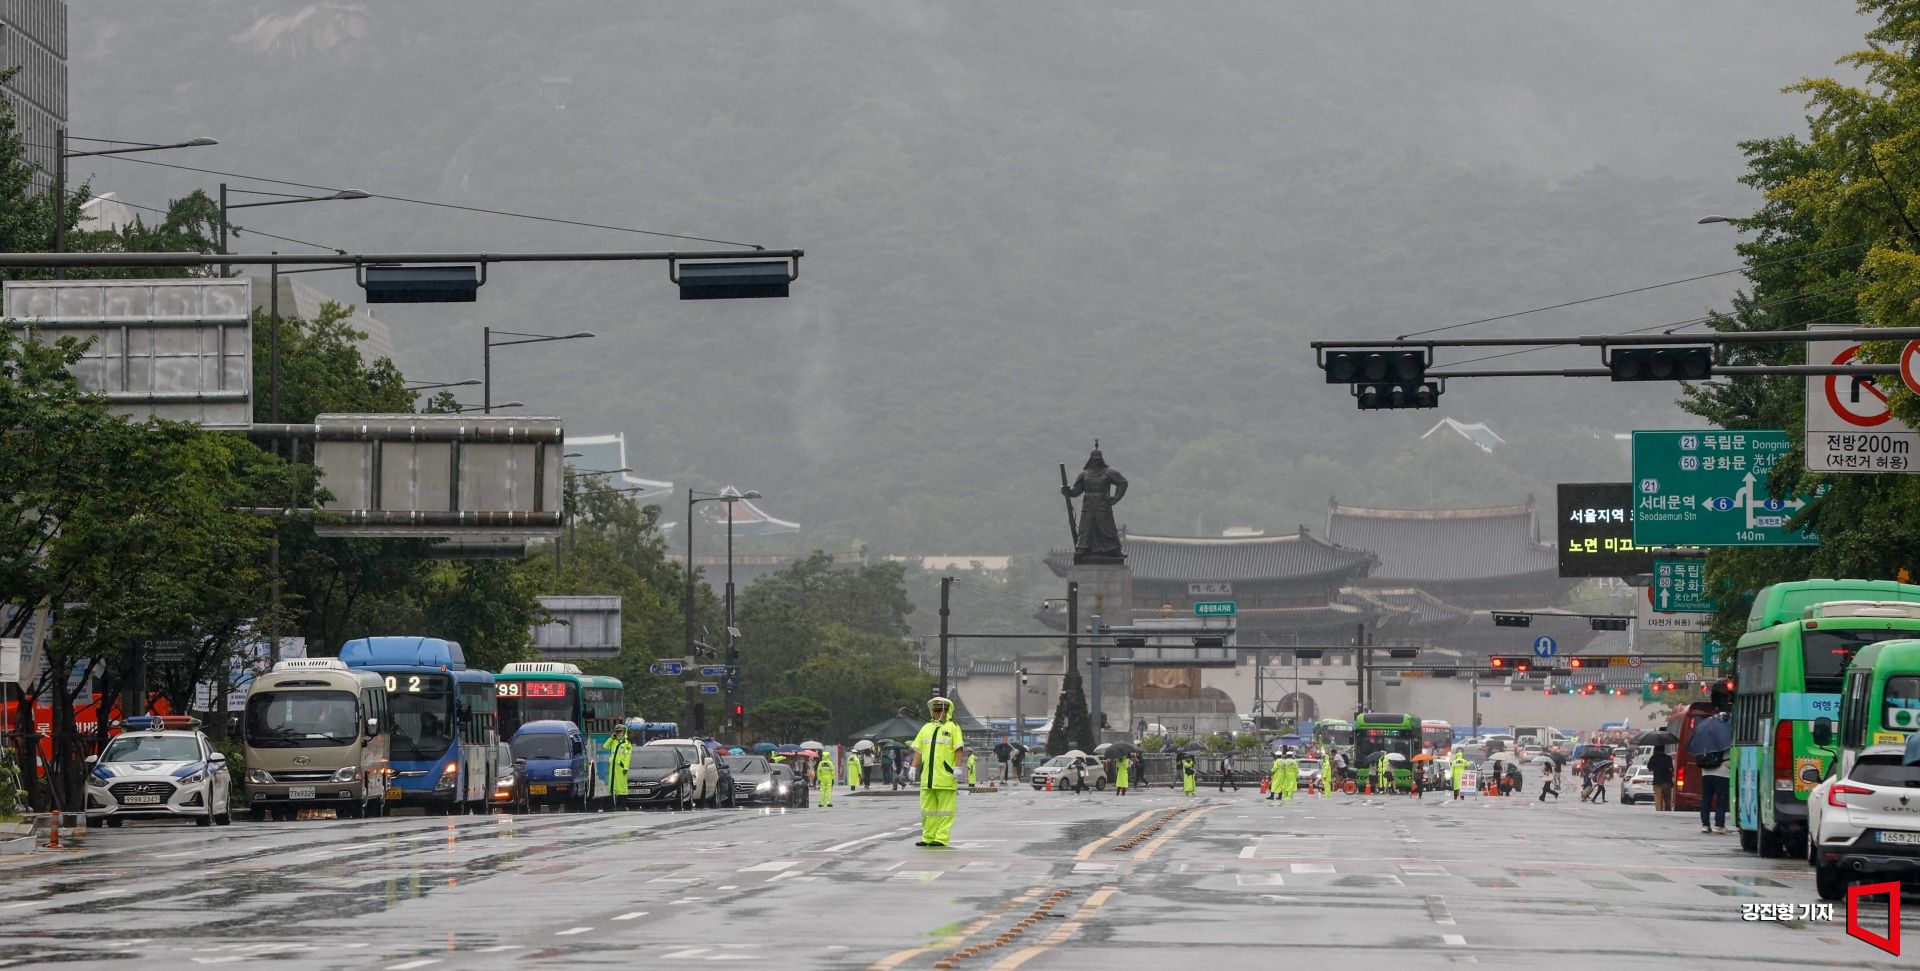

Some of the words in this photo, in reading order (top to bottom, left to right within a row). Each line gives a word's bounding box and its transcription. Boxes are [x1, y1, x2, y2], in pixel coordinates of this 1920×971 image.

[1684, 438, 1696, 447] 21
[1703, 435, 1746, 450] 독립문
[1752, 439, 1793, 451] Dongnin
[1827, 434, 1909, 454] 전방200m
[1684, 458, 1696, 468] 50
[1702, 456, 1746, 470] 광화문
[1826, 453, 1871, 468] (자전거
[1876, 456, 1908, 470] 허용)
[1644, 481, 1656, 491] 21
[1639, 495, 1696, 510] 서대문역
[1719, 498, 1727, 509] 6
[1770, 498, 1778, 509] 6
[1569, 508, 1625, 523] 서울지역
[1639, 511, 1682, 521] Seodaemun
[1684, 511, 1697, 521] Stn
[1736, 531, 1765, 541] 140m
[1568, 537, 1598, 553] 노면
[1648, 618, 1672, 627] (자전거
[1674, 618, 1691, 627] 허용)
[495, 683, 519, 696] 99
[1812, 700, 1831, 711] 여행
